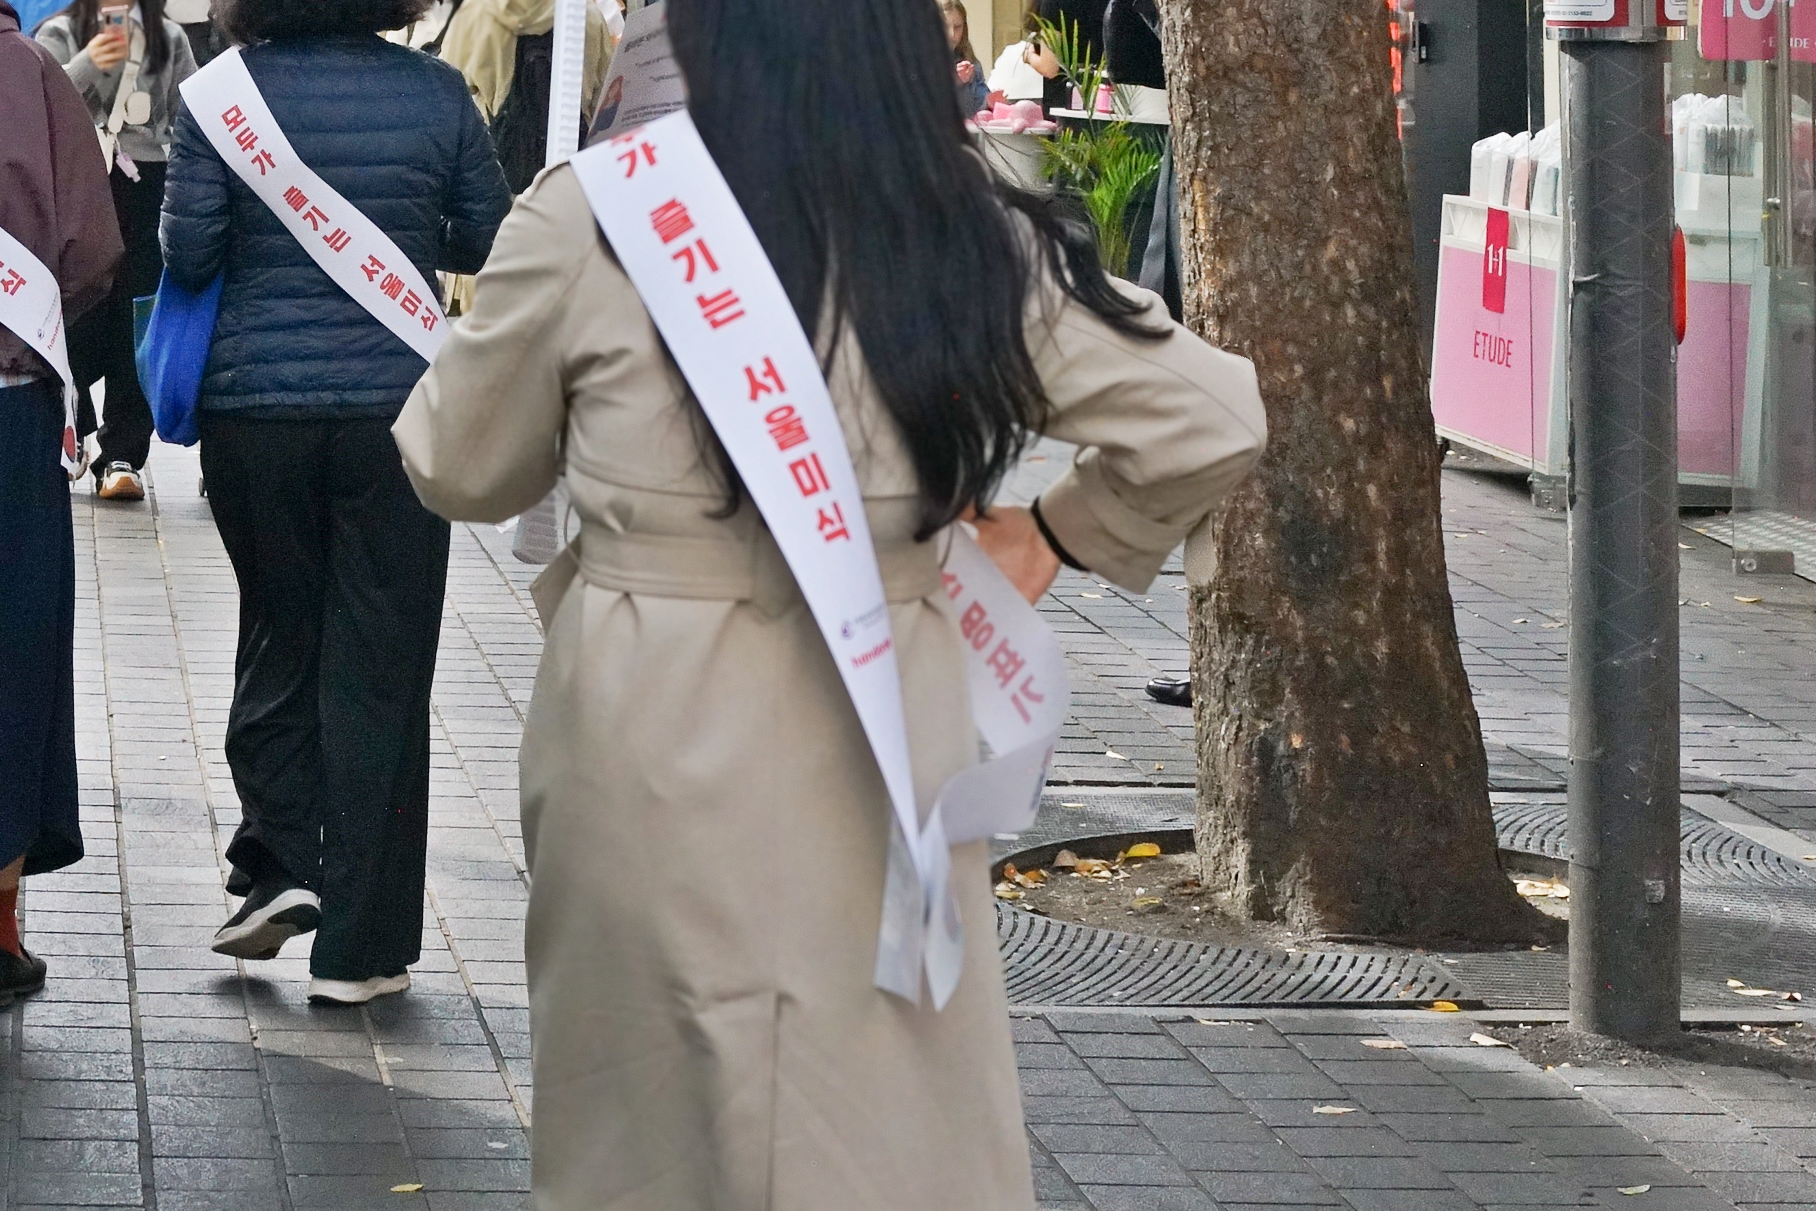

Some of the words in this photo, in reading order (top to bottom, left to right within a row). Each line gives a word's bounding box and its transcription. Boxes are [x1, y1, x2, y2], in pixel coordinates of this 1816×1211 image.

[220, 104, 277, 176] 모두가
[282, 185, 352, 253] 즐기는
[360, 254, 439, 332] 서울미식
[649, 197, 747, 330] 즐기는
[742, 357, 852, 544] 서울미식
[1473, 330, 1514, 368] ETUDE
